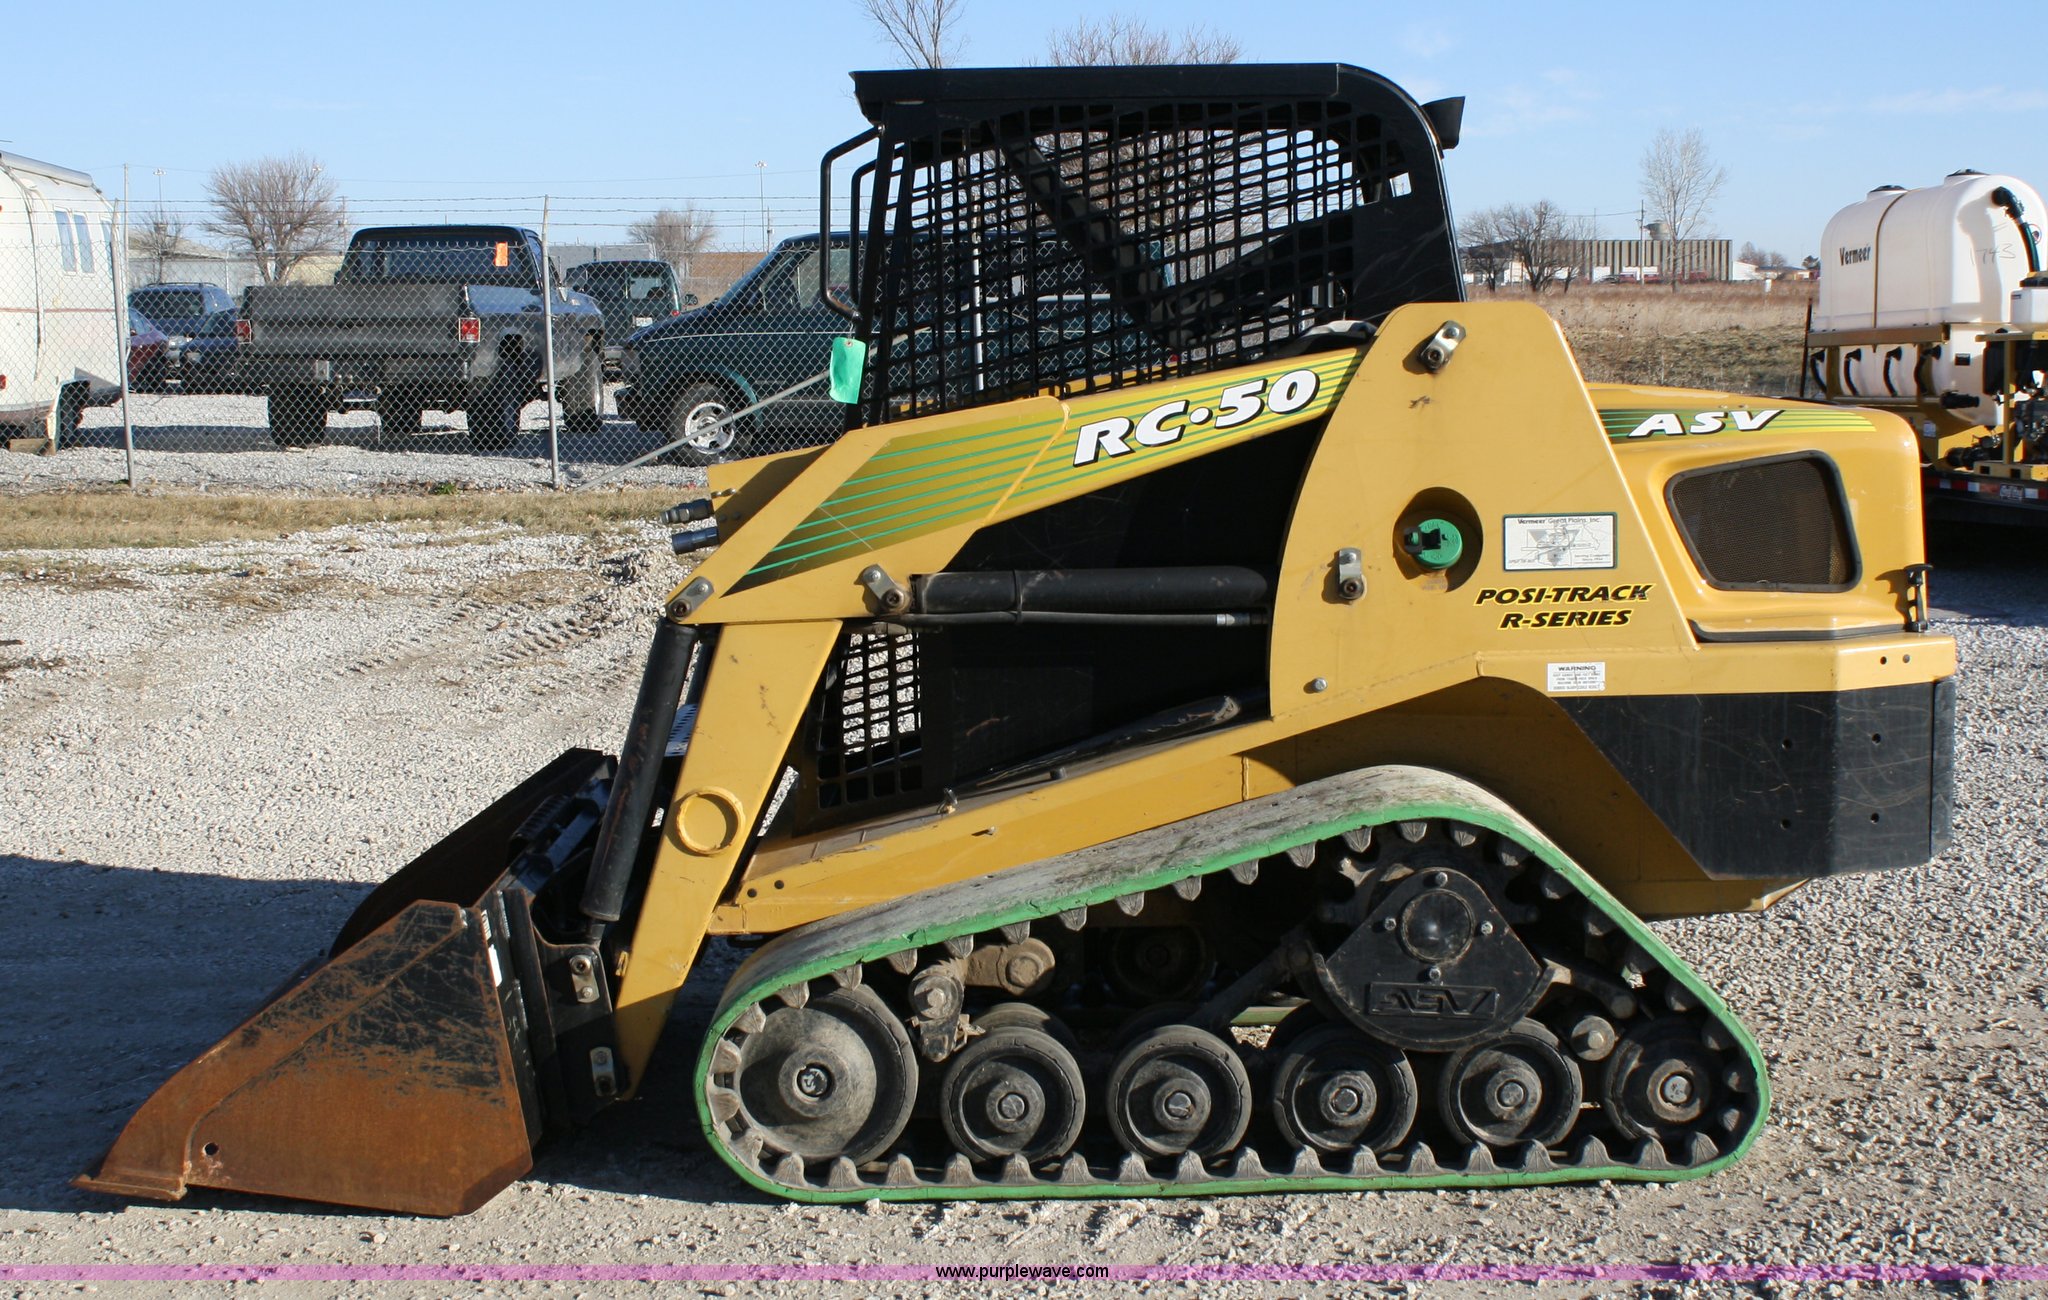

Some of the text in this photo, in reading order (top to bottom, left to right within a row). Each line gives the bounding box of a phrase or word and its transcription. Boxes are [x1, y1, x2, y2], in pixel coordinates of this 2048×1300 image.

[1839, 246, 1871, 266] Vermeer
[1627, 409, 1786, 438] ASV
[1475, 584, 1654, 605] POSI-TRACK
[1499, 610, 1632, 629] R-SERIES
[1369, 984, 1495, 1017] ASV
